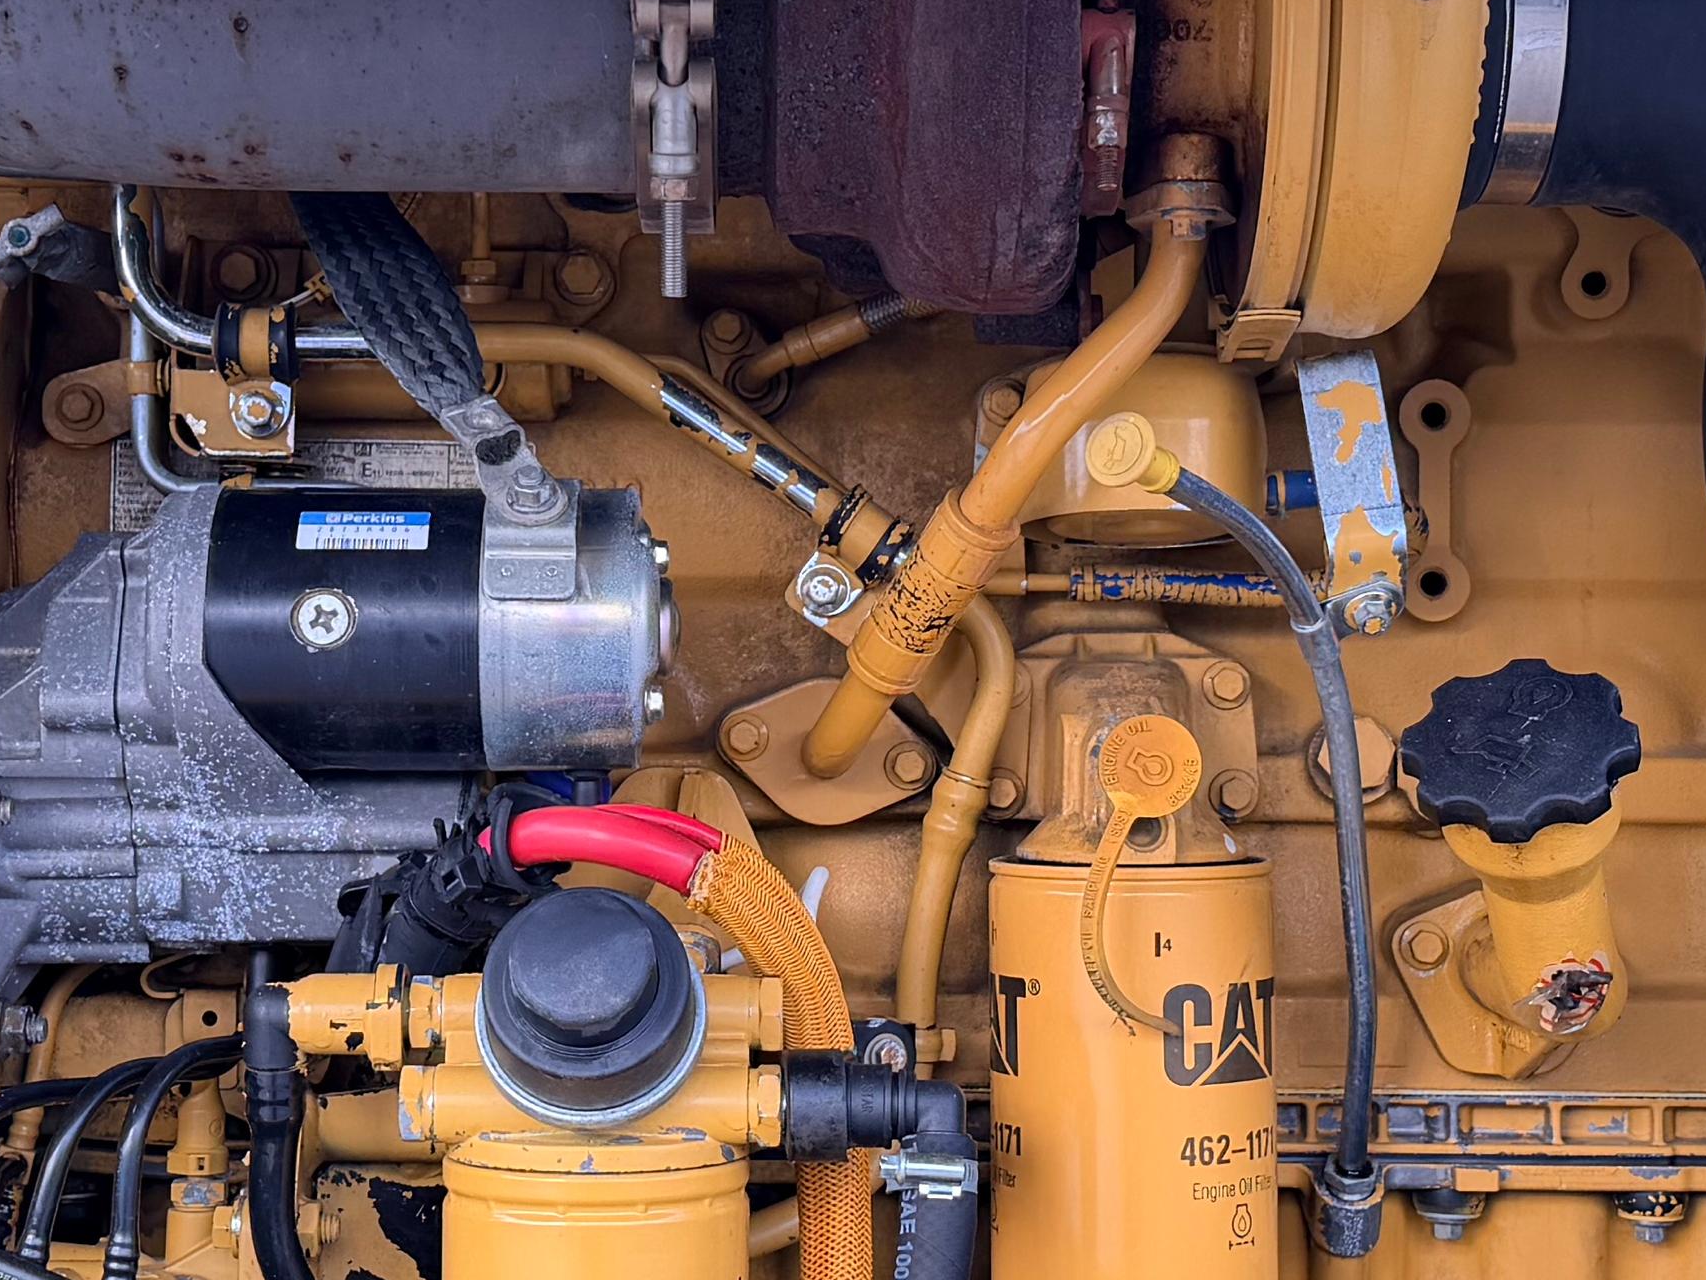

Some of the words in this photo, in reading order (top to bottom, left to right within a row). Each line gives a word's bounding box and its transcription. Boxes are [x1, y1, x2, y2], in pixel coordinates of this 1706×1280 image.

[341, 513, 406, 524] Perkins
[1103, 733, 1126, 787] ENGINE
[1126, 720, 1154, 737] OIL
[1162, 976, 1274, 1087] CAT
[1180, 1125, 1274, 1167] 462-1171
[899, 1188, 918, 1235] SAE
[1193, 1182, 1236, 1203] Engine
[1239, 1177, 1253, 1196] Oil
